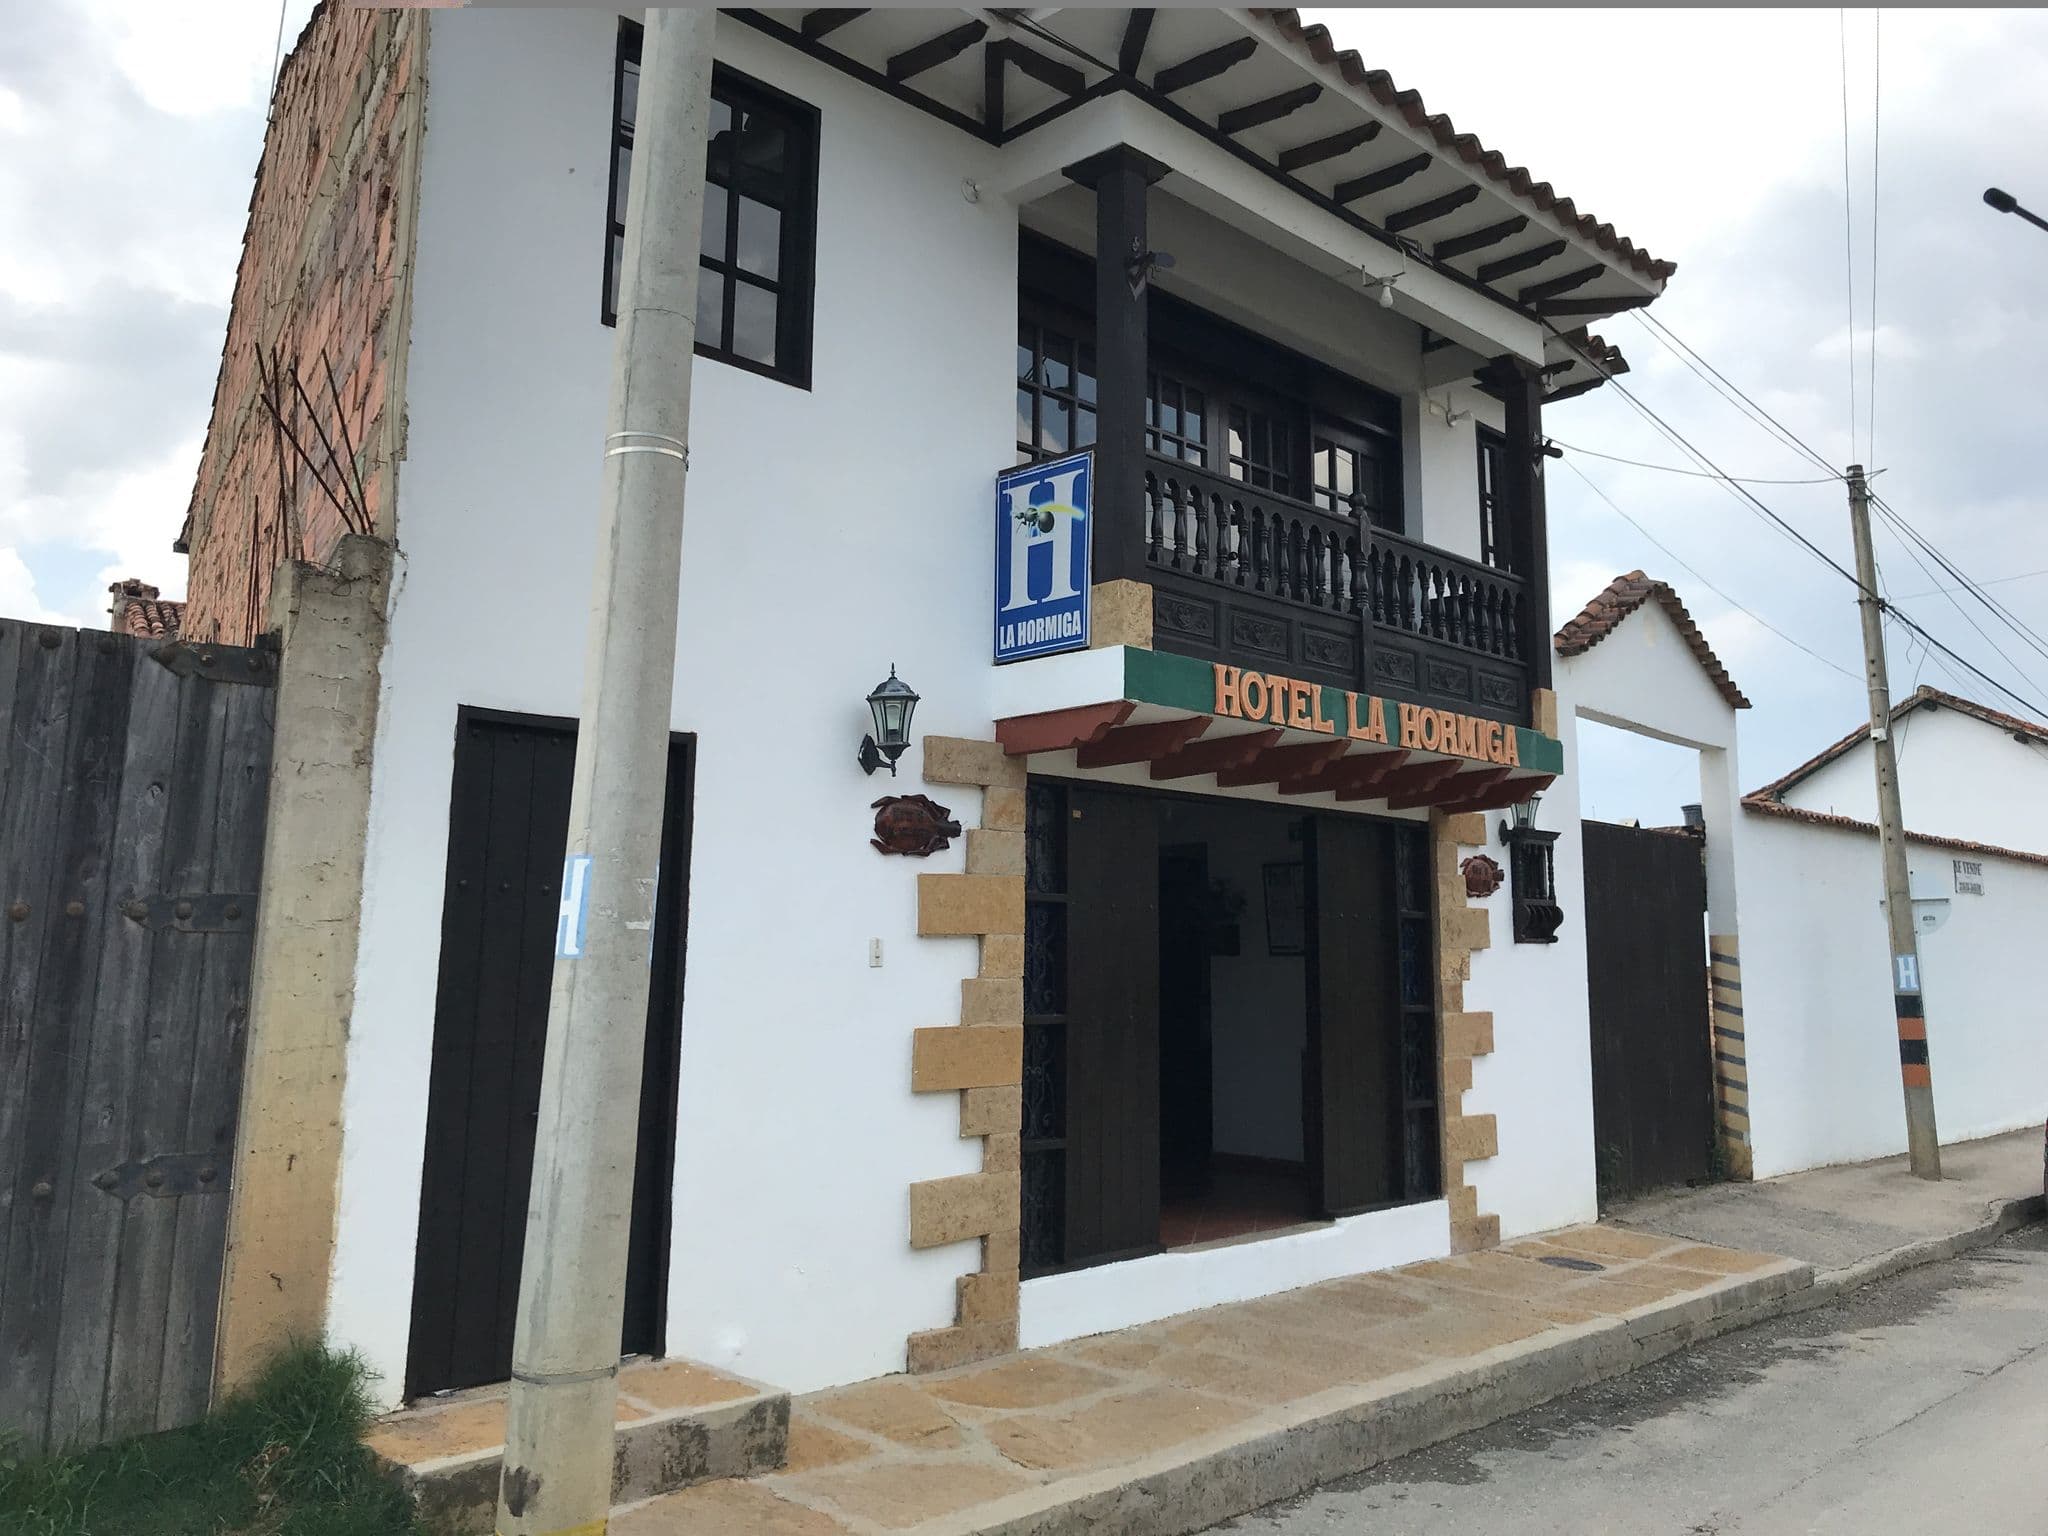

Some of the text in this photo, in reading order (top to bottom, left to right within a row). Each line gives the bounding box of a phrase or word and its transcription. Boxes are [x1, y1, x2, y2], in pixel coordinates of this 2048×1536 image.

[1001, 468, 1084, 612] H
[1000, 610, 1081, 650] LA HORMIGA
[1213, 663, 1520, 767] HOTEL LA HORMIGA
[1896, 957, 1918, 989] H
